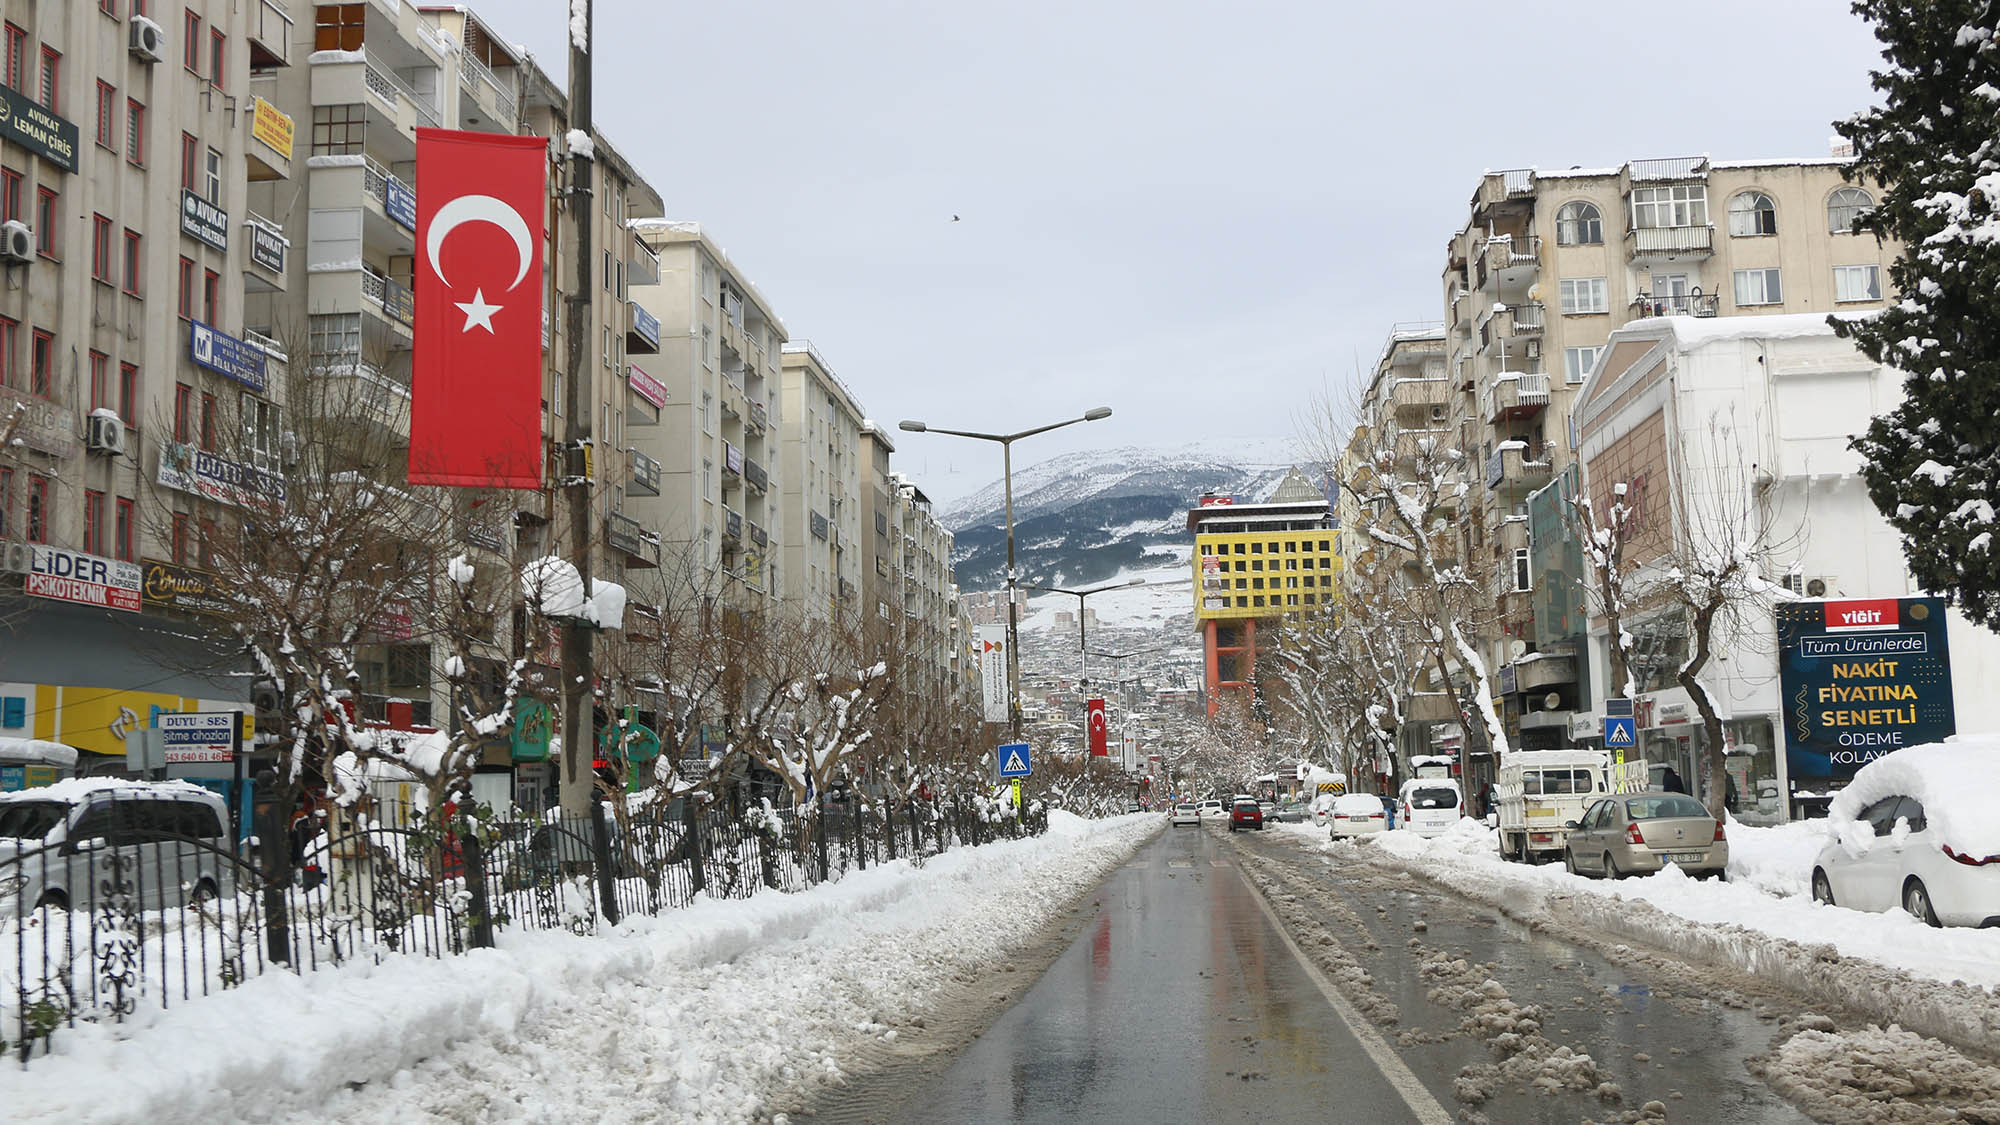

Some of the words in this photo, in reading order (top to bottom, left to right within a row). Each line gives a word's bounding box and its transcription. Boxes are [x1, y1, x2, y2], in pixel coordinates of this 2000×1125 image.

[28, 108, 60, 132] AVUKAT
[14, 116, 47, 144] LEMAN
[196, 201, 227, 231] AVUKAT
[256, 231, 282, 255] AVUKAT
[1841, 609, 1882, 624] YİĞİT
[1805, 640, 1840, 653] Tüm
[1844, 637, 1922, 652] Ürünlerde
[1832, 658, 1899, 679] NAKİT
[1818, 683, 1918, 703] FİYATINA
[167, 717, 197, 727] DUYU
[207, 716, 228, 726] SES
[1821, 704, 1917, 727] SENETLİ
[164, 731, 190, 745] şitme
[1838, 731, 1903, 746] ÖDEME
[165, 753, 179, 761] 543
[1829, 750, 1889, 764] KOLAY
